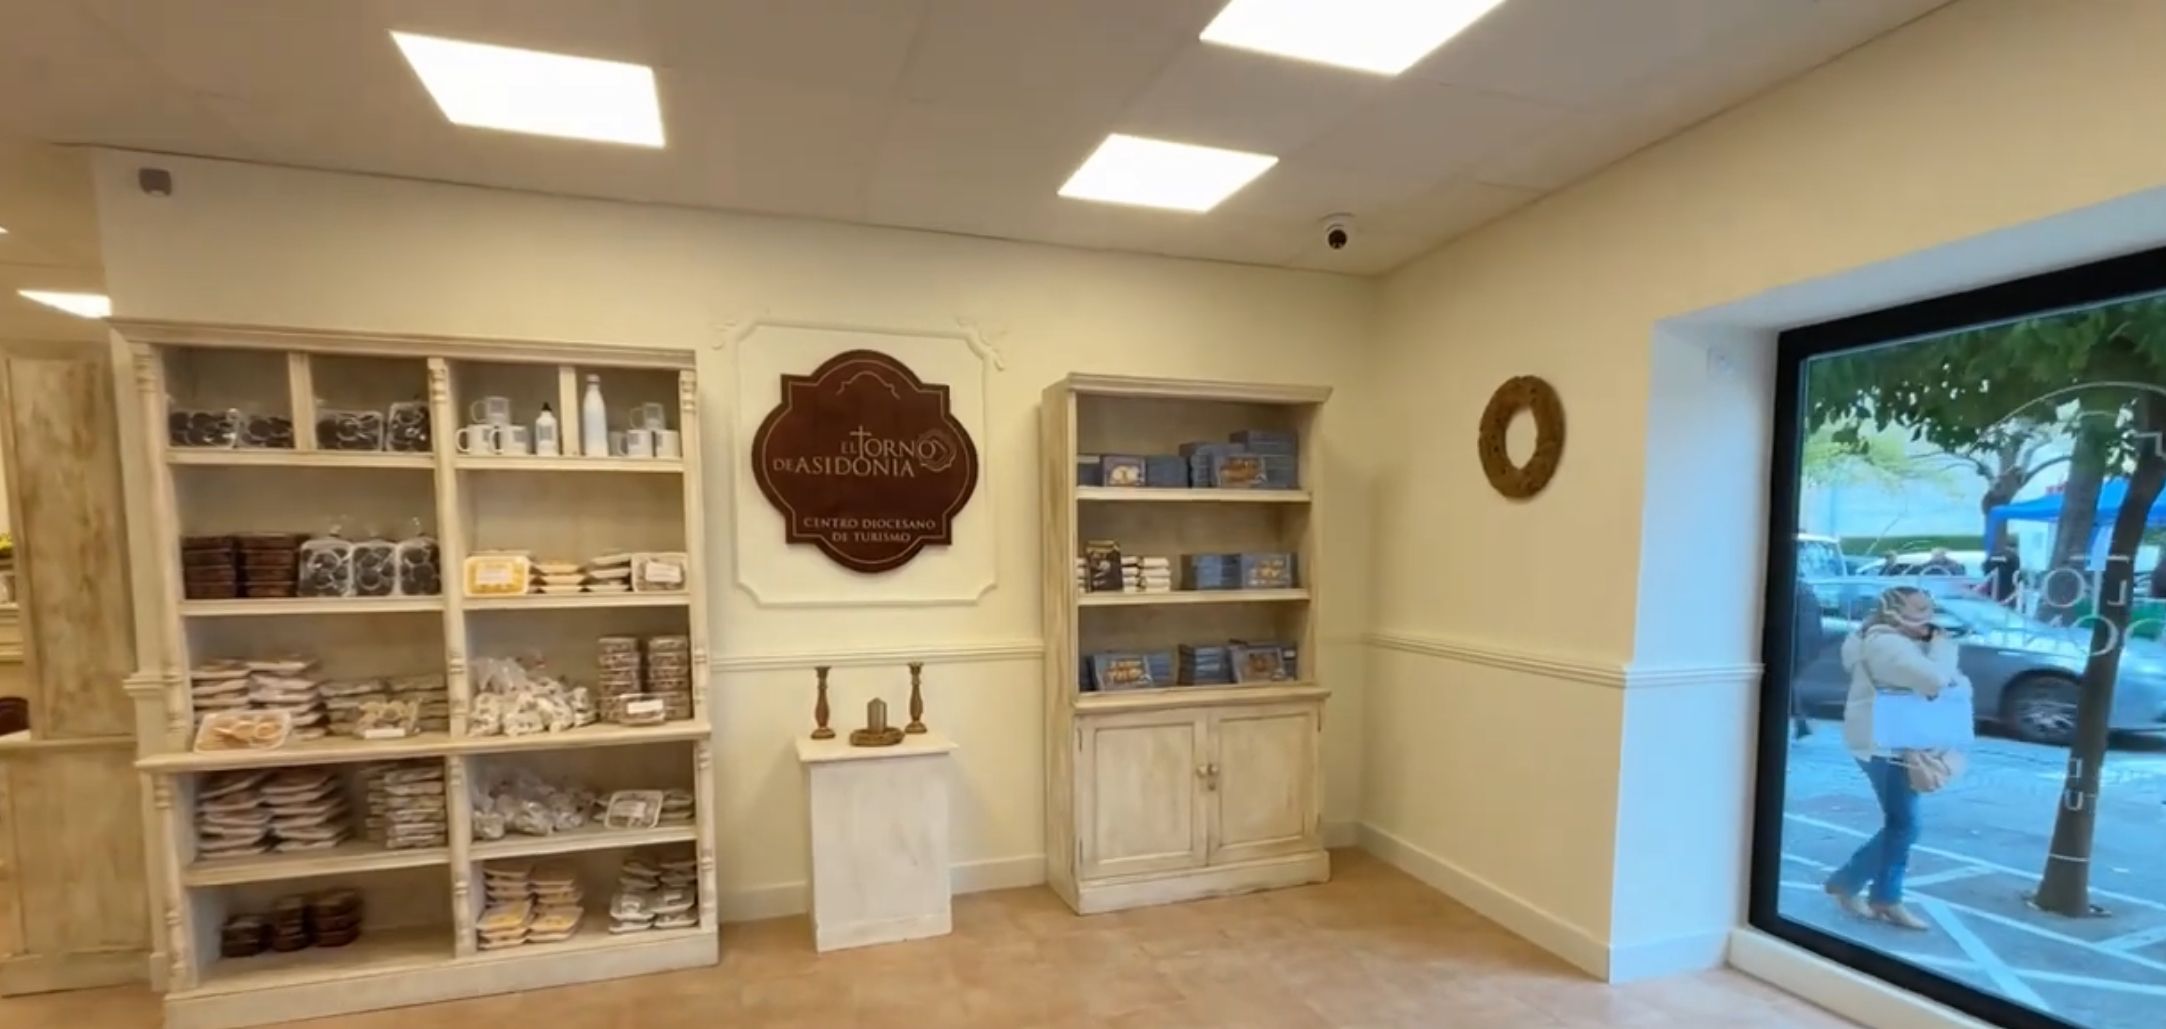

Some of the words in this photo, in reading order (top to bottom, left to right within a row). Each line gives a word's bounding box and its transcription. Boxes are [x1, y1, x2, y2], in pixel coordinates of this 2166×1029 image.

[841, 441, 857, 454] EL
[849, 425, 936, 459] TORNO
[773, 459, 793, 471] DE
[795, 456, 915, 477] ASIDONIA
[803, 517, 859, 528] CENTRO
[862, 518, 936, 530] DIOCESANO
[832, 532, 847, 542] DE
[854, 532, 911, 543] TURISMO
